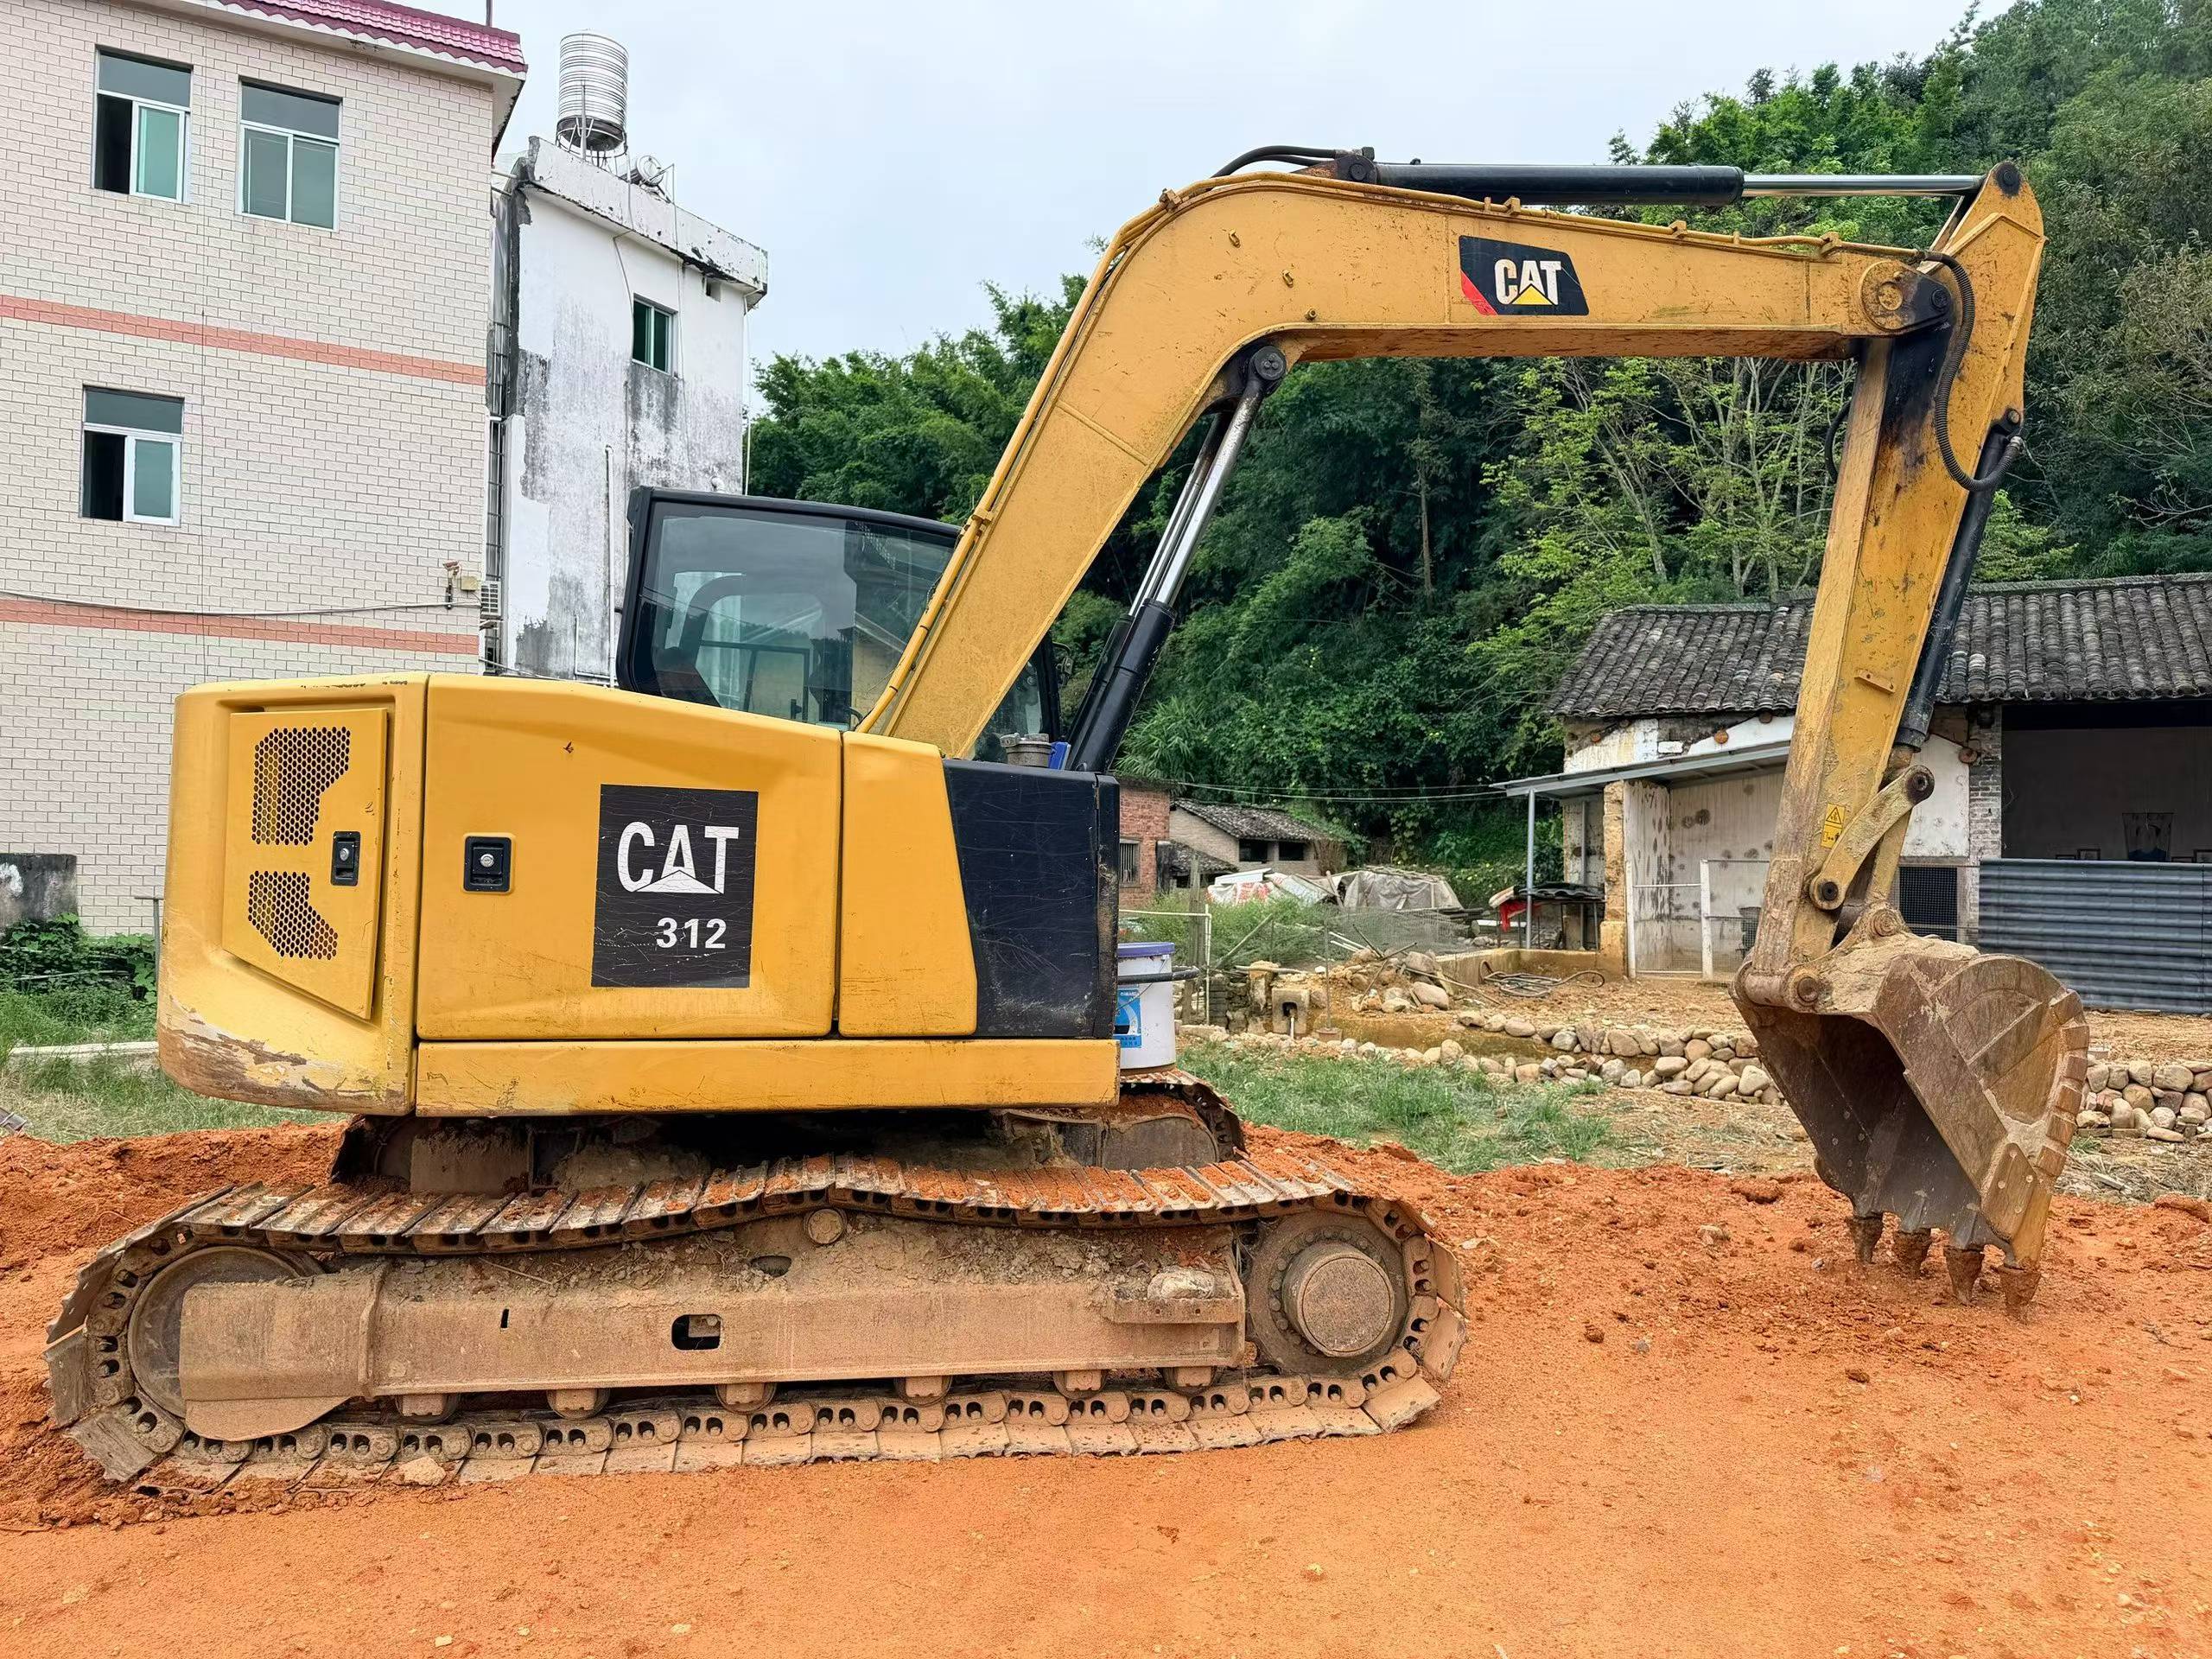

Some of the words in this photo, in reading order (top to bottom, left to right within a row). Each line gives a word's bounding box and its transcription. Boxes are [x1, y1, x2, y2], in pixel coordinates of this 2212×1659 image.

[1494, 258, 1562, 306] CAT
[617, 821, 740, 894] CAT
[656, 917, 728, 949] 312
